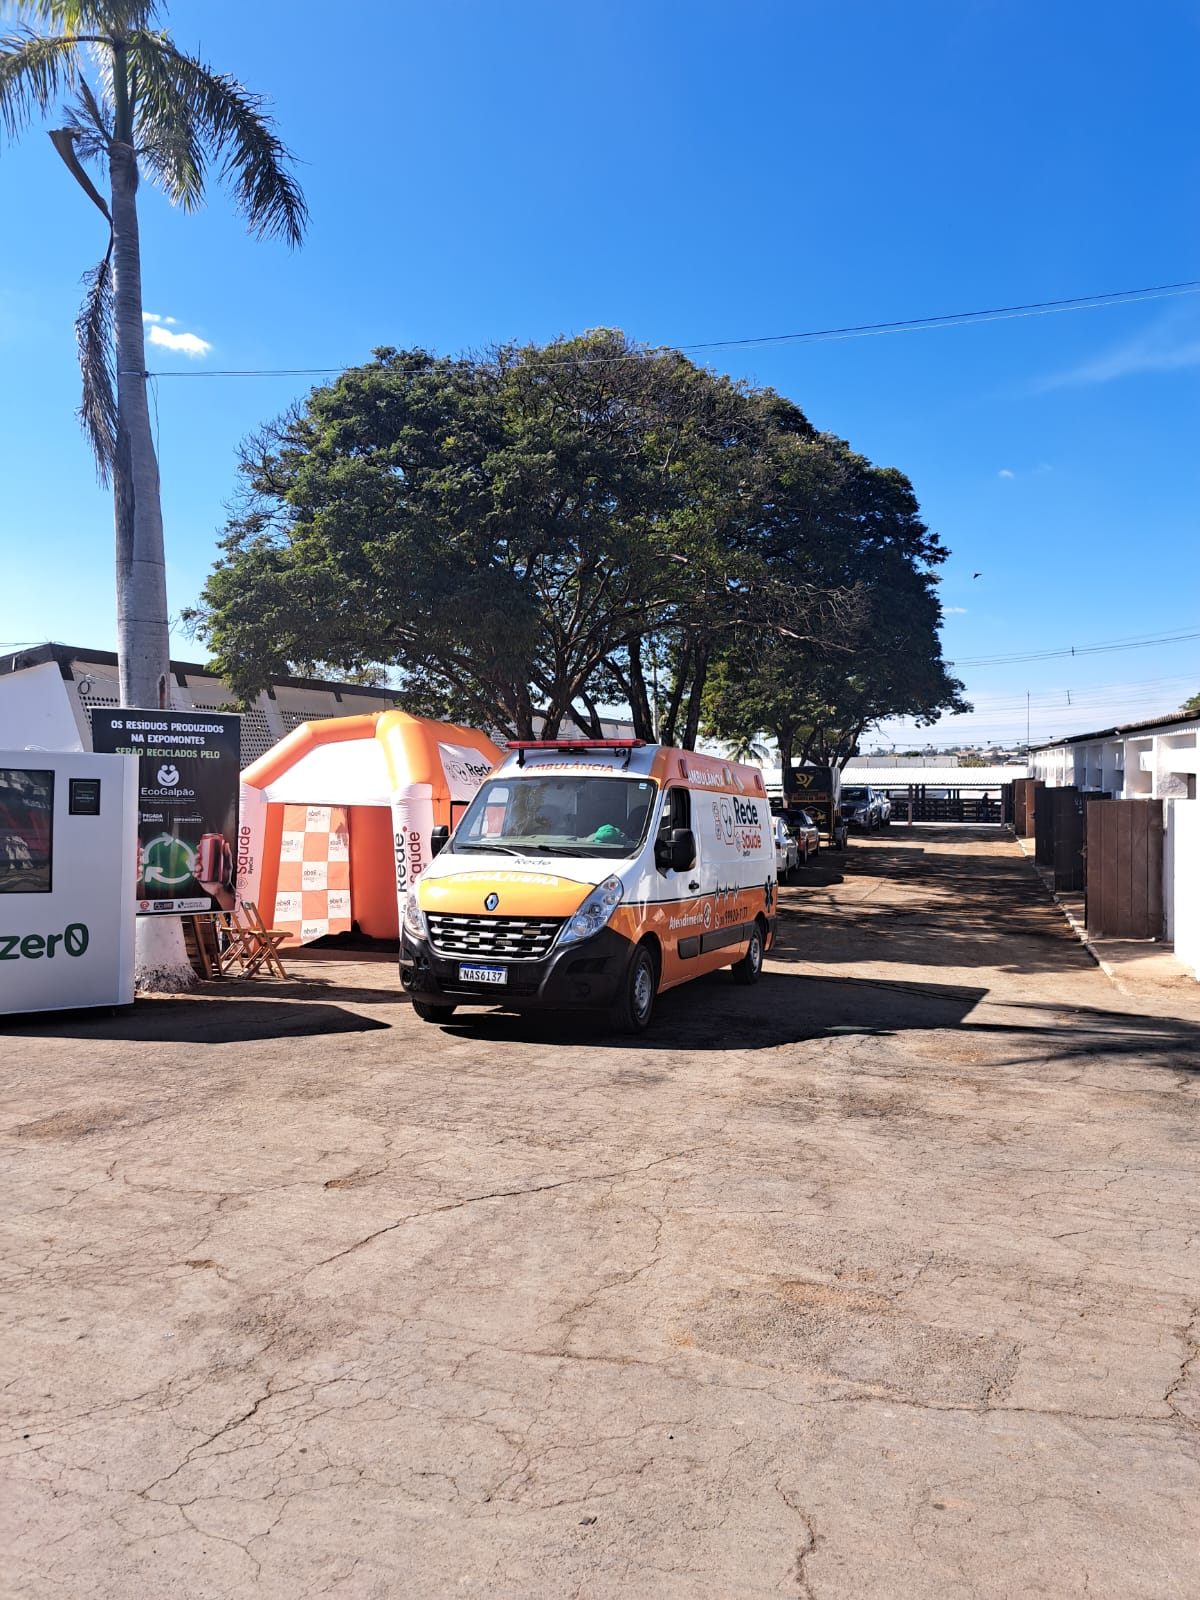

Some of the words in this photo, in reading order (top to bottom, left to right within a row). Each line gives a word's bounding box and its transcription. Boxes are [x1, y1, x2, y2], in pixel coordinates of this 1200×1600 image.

[111, 720, 123, 729] OS
[126, 720, 169, 731] RESÍDUOS
[171, 723, 225, 733] PRODUZIDOS
[131, 734, 144, 743] NA
[148, 735, 206, 745] EXPOMONTES
[147, 748, 198, 758] RECICLADOS
[201, 750, 220, 759] PELO
[526, 761, 614, 773] AMBULÂNCIA
[141, 788, 195, 797] EcoGalpão
[733, 796, 759, 825] Rede
[741, 829, 762, 849] Saúde
